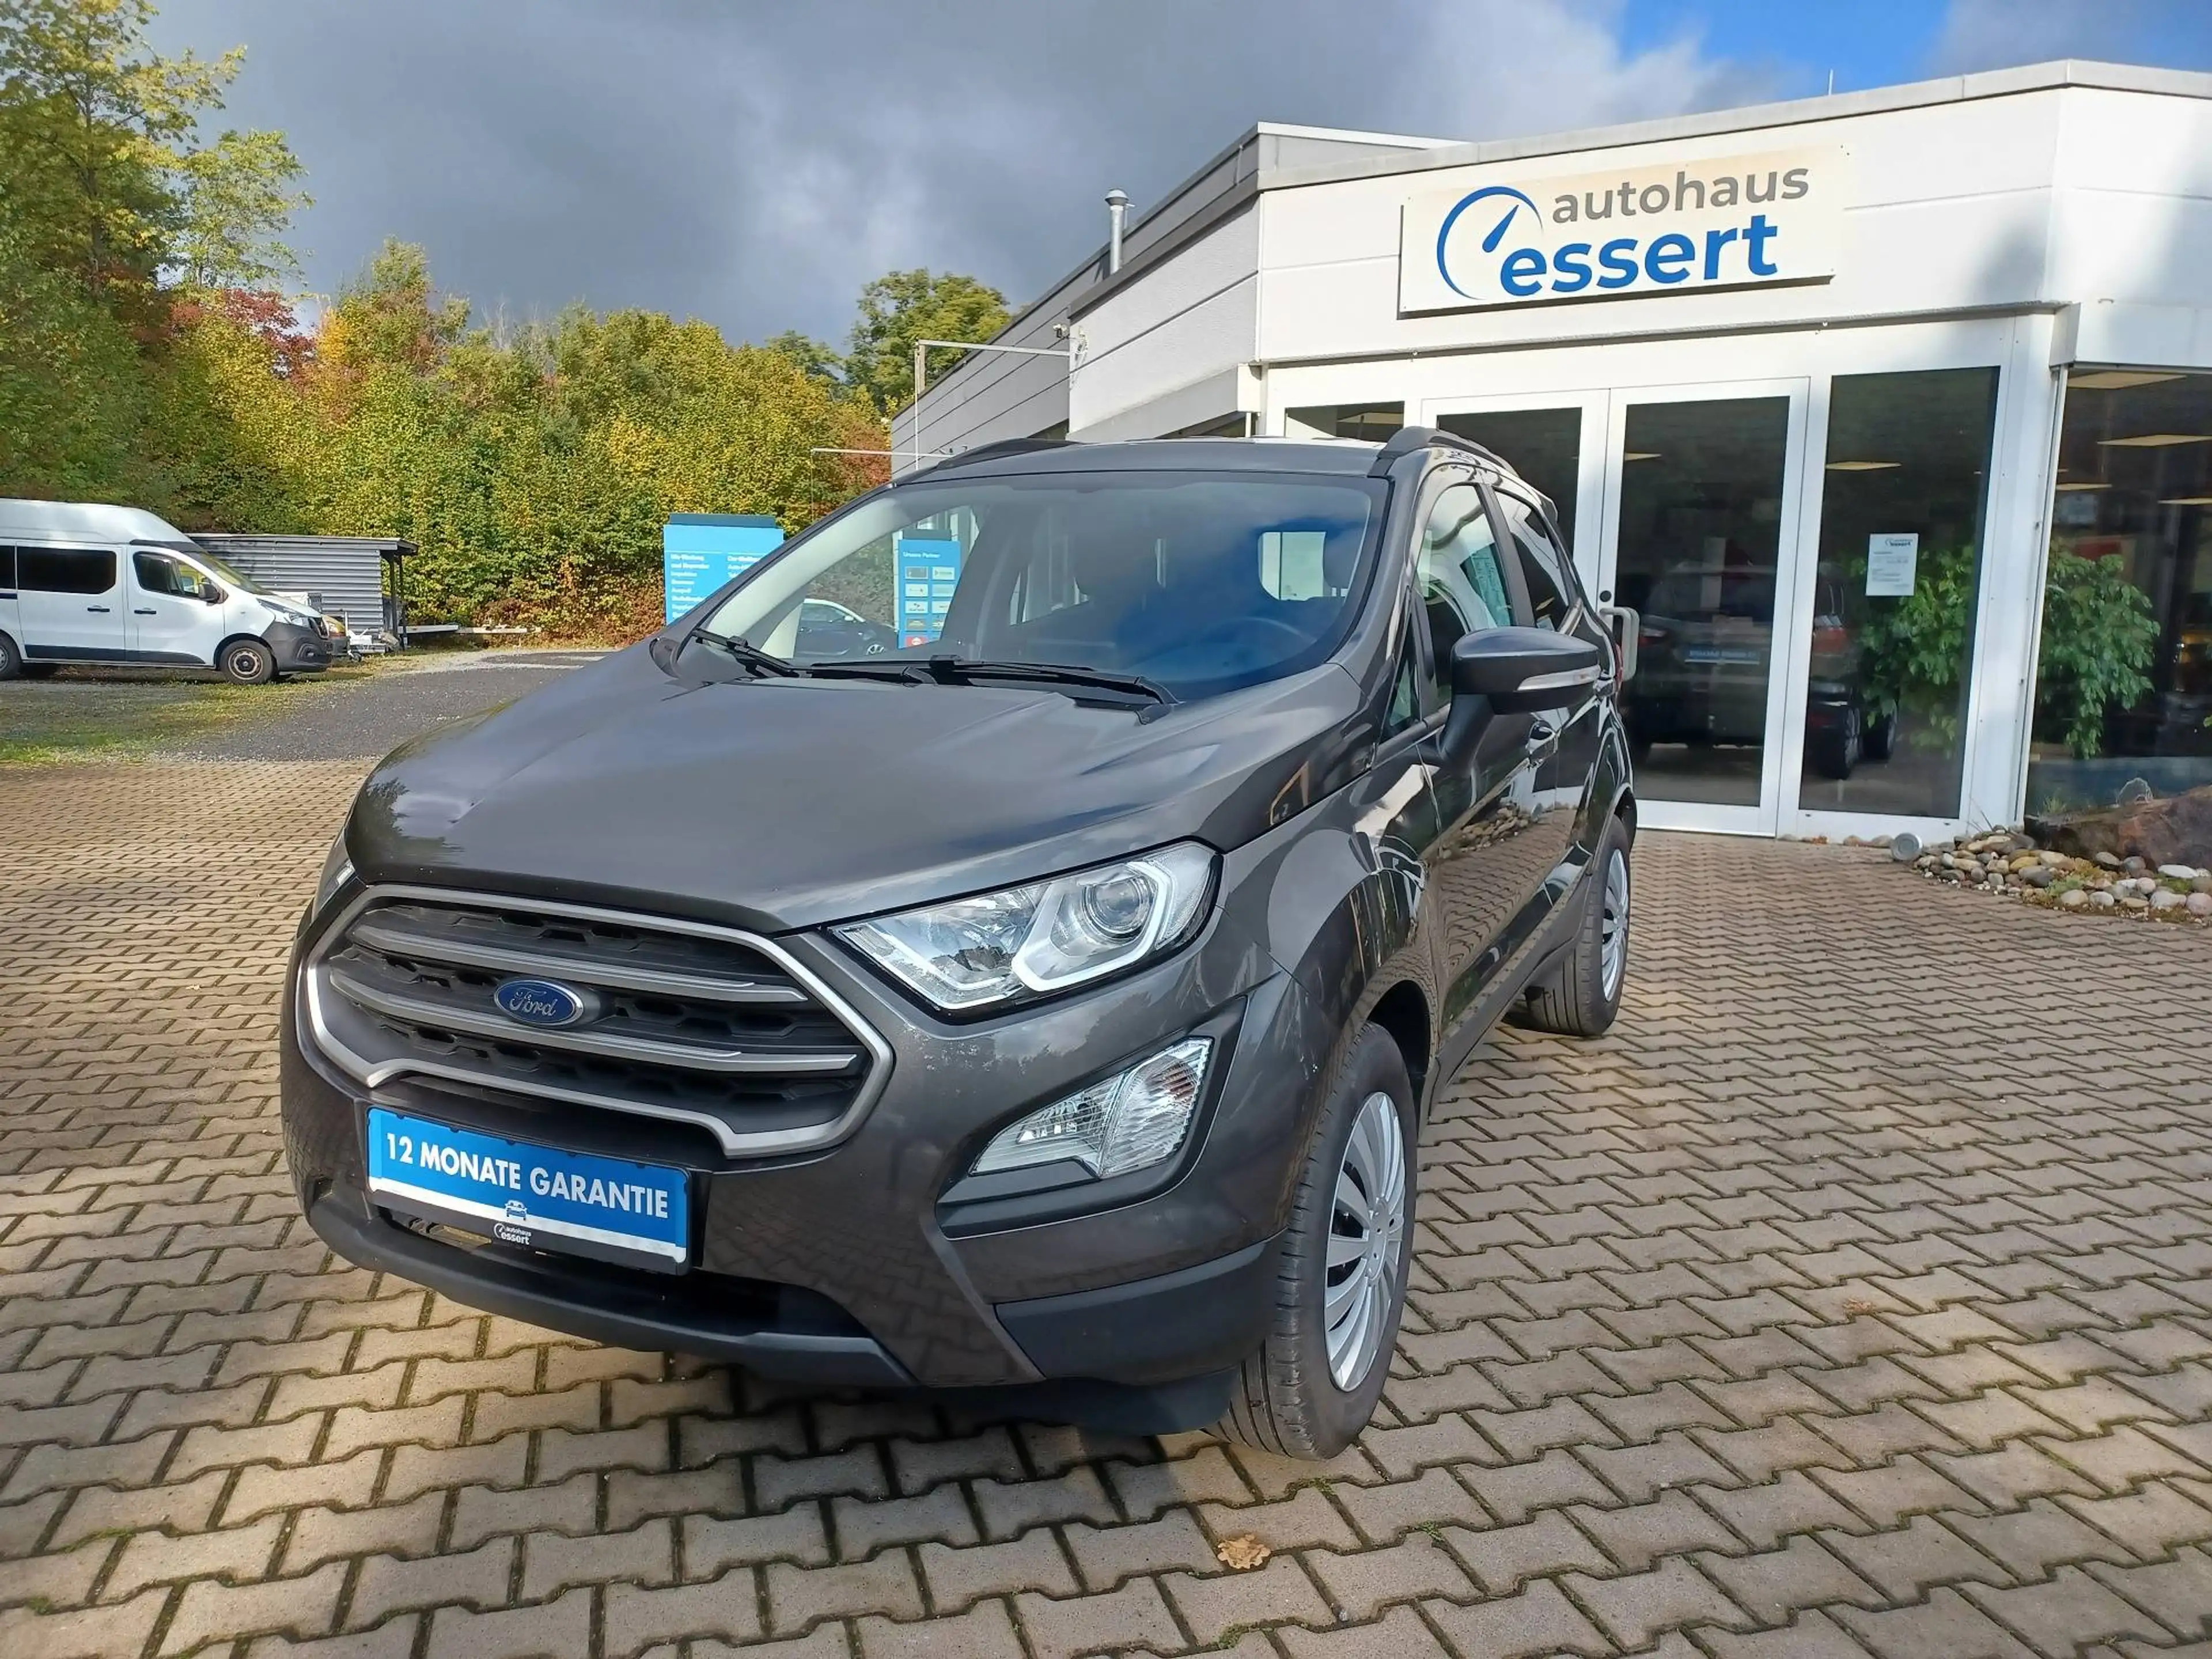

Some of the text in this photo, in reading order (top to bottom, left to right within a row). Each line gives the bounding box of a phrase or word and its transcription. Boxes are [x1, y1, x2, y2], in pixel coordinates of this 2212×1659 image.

[1552, 168, 1809, 223] autohaus
[1499, 214, 1778, 297] essert
[509, 986, 559, 1017] Ford
[387, 1132, 668, 1218] 12 MONATE GARANTIE
[501, 1232, 530, 1245] essert
[505, 1226, 532, 1237] autohaus
